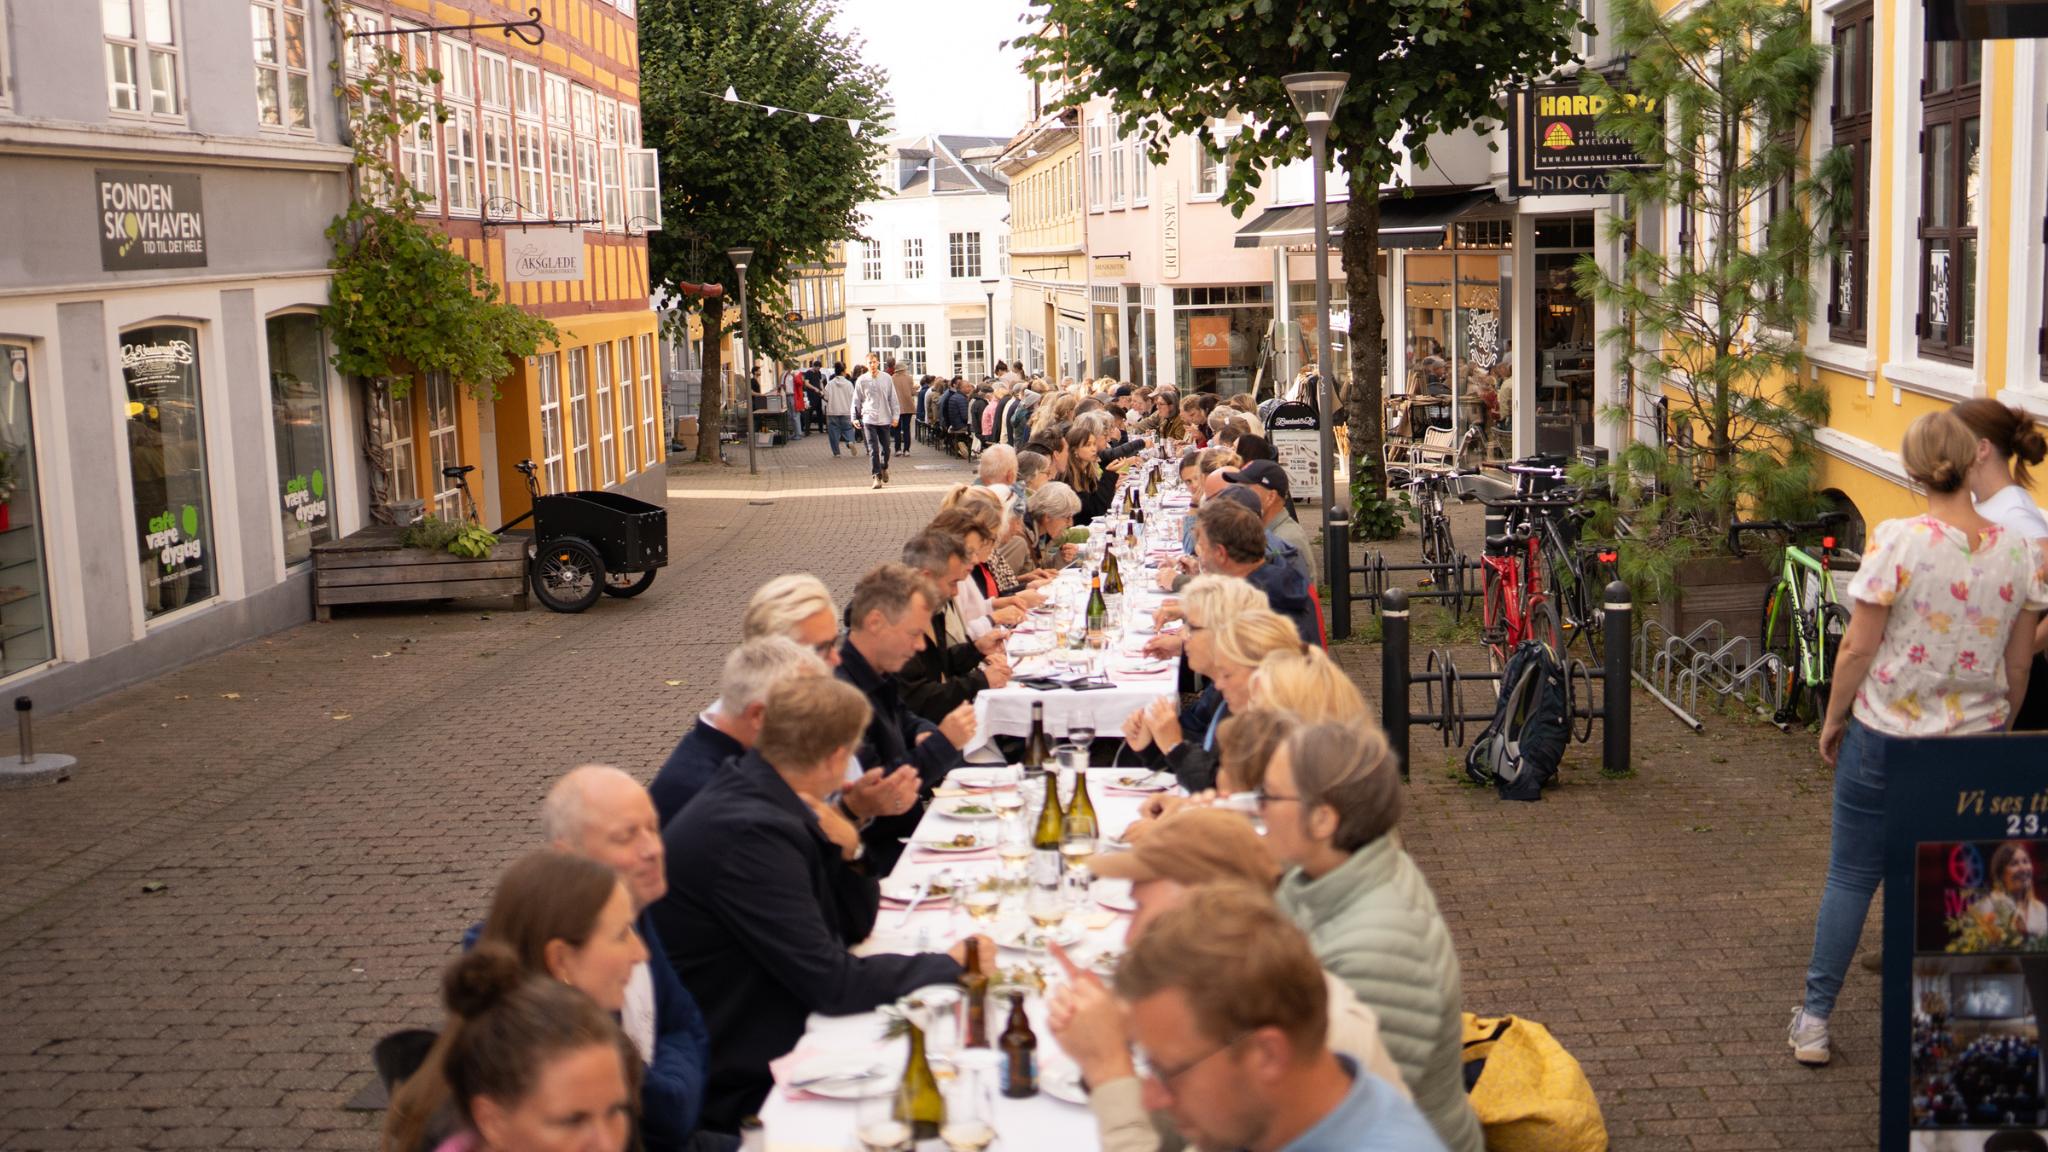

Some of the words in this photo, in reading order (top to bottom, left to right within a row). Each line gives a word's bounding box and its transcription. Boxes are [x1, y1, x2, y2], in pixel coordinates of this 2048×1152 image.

[101, 181, 173, 211] FONDEN
[143, 240, 156, 254] TID
[157, 240, 168, 253] TIL
[168, 240, 183, 253] DET
[184, 240, 203, 253] HELE
[284, 489, 309, 508] være
[148, 510, 176, 533] cafe
[296, 500, 326, 522] dygtig
[145, 527, 179, 550] være
[161, 539, 202, 566] dygtig
[1957, 789, 1985, 816] Vi
[1989, 795, 2025, 815] ses
